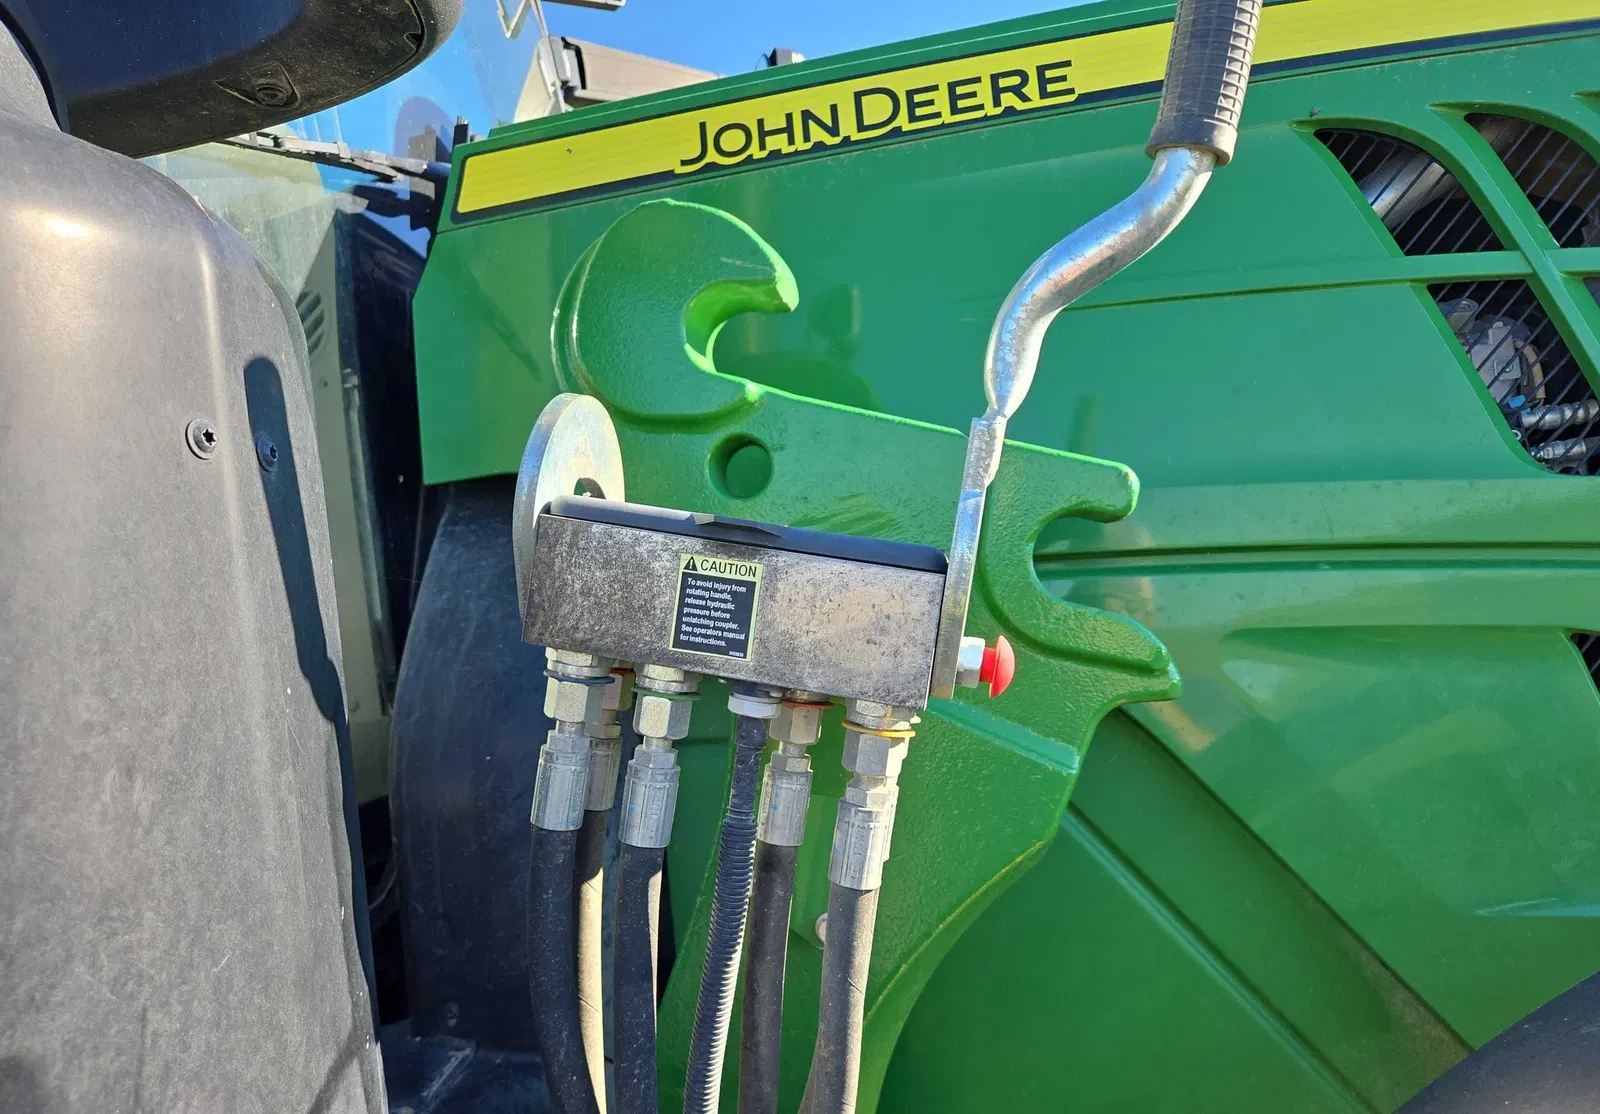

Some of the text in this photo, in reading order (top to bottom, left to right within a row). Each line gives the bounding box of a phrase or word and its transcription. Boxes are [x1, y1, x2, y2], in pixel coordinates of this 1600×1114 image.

[680, 60, 1076, 166] JOHN DEERE
[700, 558, 757, 578] CAUTION
[687, 578, 747, 593] To avoid injury from
[686, 588, 733, 601] rotating handle,
[684, 597, 736, 610] release hydraulic
[683, 607, 731, 619] pressure before
[682, 616, 740, 630] unlatching coupler.
[681, 624, 693, 632] See
[723, 631, 746, 640] manual
[679, 633, 727, 647] for instructions.
